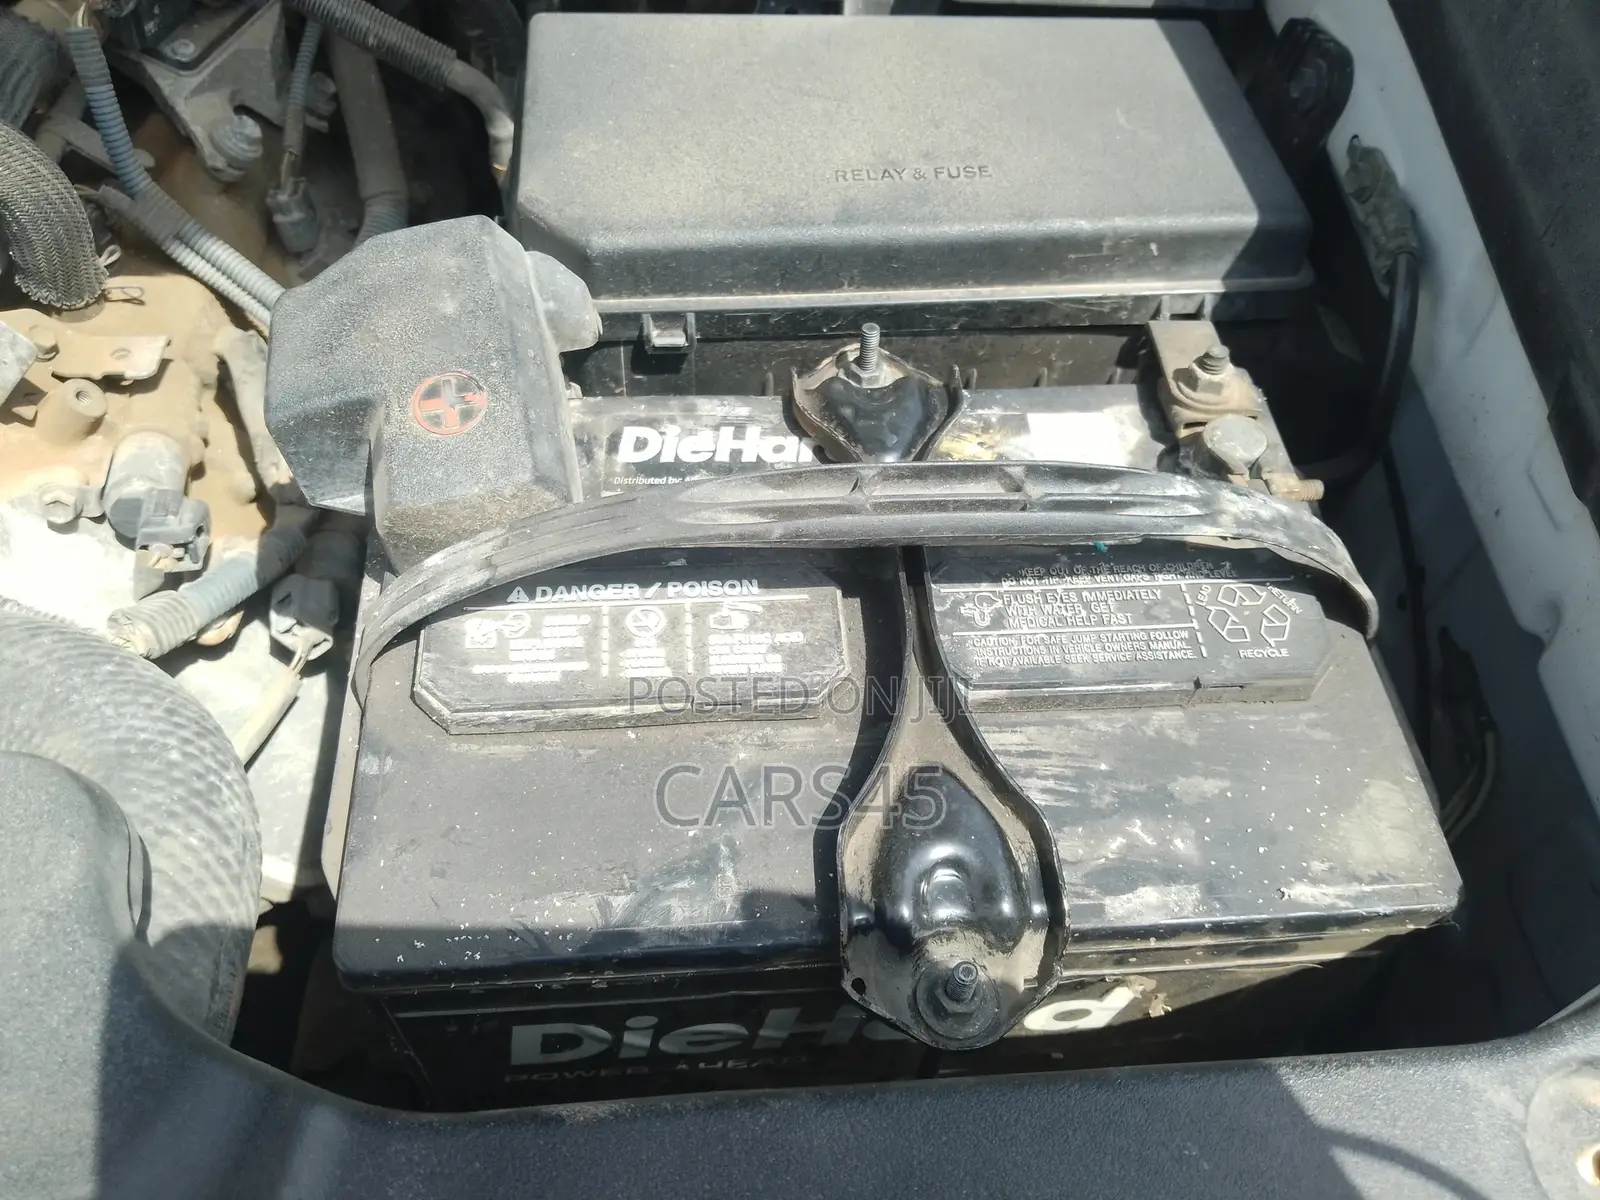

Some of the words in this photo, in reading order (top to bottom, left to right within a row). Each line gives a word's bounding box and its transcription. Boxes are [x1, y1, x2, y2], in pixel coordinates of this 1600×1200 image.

[835, 167, 906, 182] RELAY
[912, 167, 928, 181] &
[934, 165, 993, 180] FUSE
[616, 423, 814, 463] DieHa
[614, 476, 667, 485] Distributed
[1020, 567, 1046, 577] KEEP
[1049, 565, 1069, 575] OUT
[1113, 563, 1146, 573] REACH
[1149, 563, 1163, 572] OF
[1164, 560, 1214, 571] CHILDREN
[1001, 577, 1017, 587] DO
[1020, 576, 1041, 586] NOT
[1093, 573, 1120, 583] VENT
[534, 582, 640, 603] DANGER
[644, 581, 662, 599] /
[666, 578, 760, 598] POISON
[1002, 592, 1042, 606] FLUSH
[1046, 590, 1077, 603] EYES
[1083, 587, 1161, 603] IMMEDIATELY
[1195, 584, 1212, 606] LEAD
[1267, 584, 1304, 615] RETURN
[1006, 604, 1037, 618] WITH
[1092, 601, 1115, 613] GET
[1009, 615, 1063, 629] MEDICAL
[1067, 614, 1098, 627] HELP
[1103, 612, 1133, 625] FAST
[1021, 634, 1043, 645] FOR
[1044, 635, 1068, 645] SAFE
[1071, 633, 1097, 644] JUMP
[1099, 631, 1148, 643] STARTING
[1150, 630, 1189, 641] FOLLOW
[976, 645, 1046, 658] INSTRUCTIONS
[1049, 645, 1060, 655] IN
[1061, 643, 1102, 655] VEHICLE
[1104, 641, 1147, 653] OWNERS
[1148, 639, 1192, 651] MANUAL.
[1238, 648, 1290, 660] RECYCLE
[974, 656, 985, 667] IF
[987, 656, 1008, 667] NOT
[1012, 655, 1061, 667] AVAILABLE
[1064, 653, 1091, 665] SEEK
[1091, 651, 1132, 663] SERVICE
[1135, 649, 1197, 661] ASSISTANCE.
[503, 1065, 651, 1083] POWER
